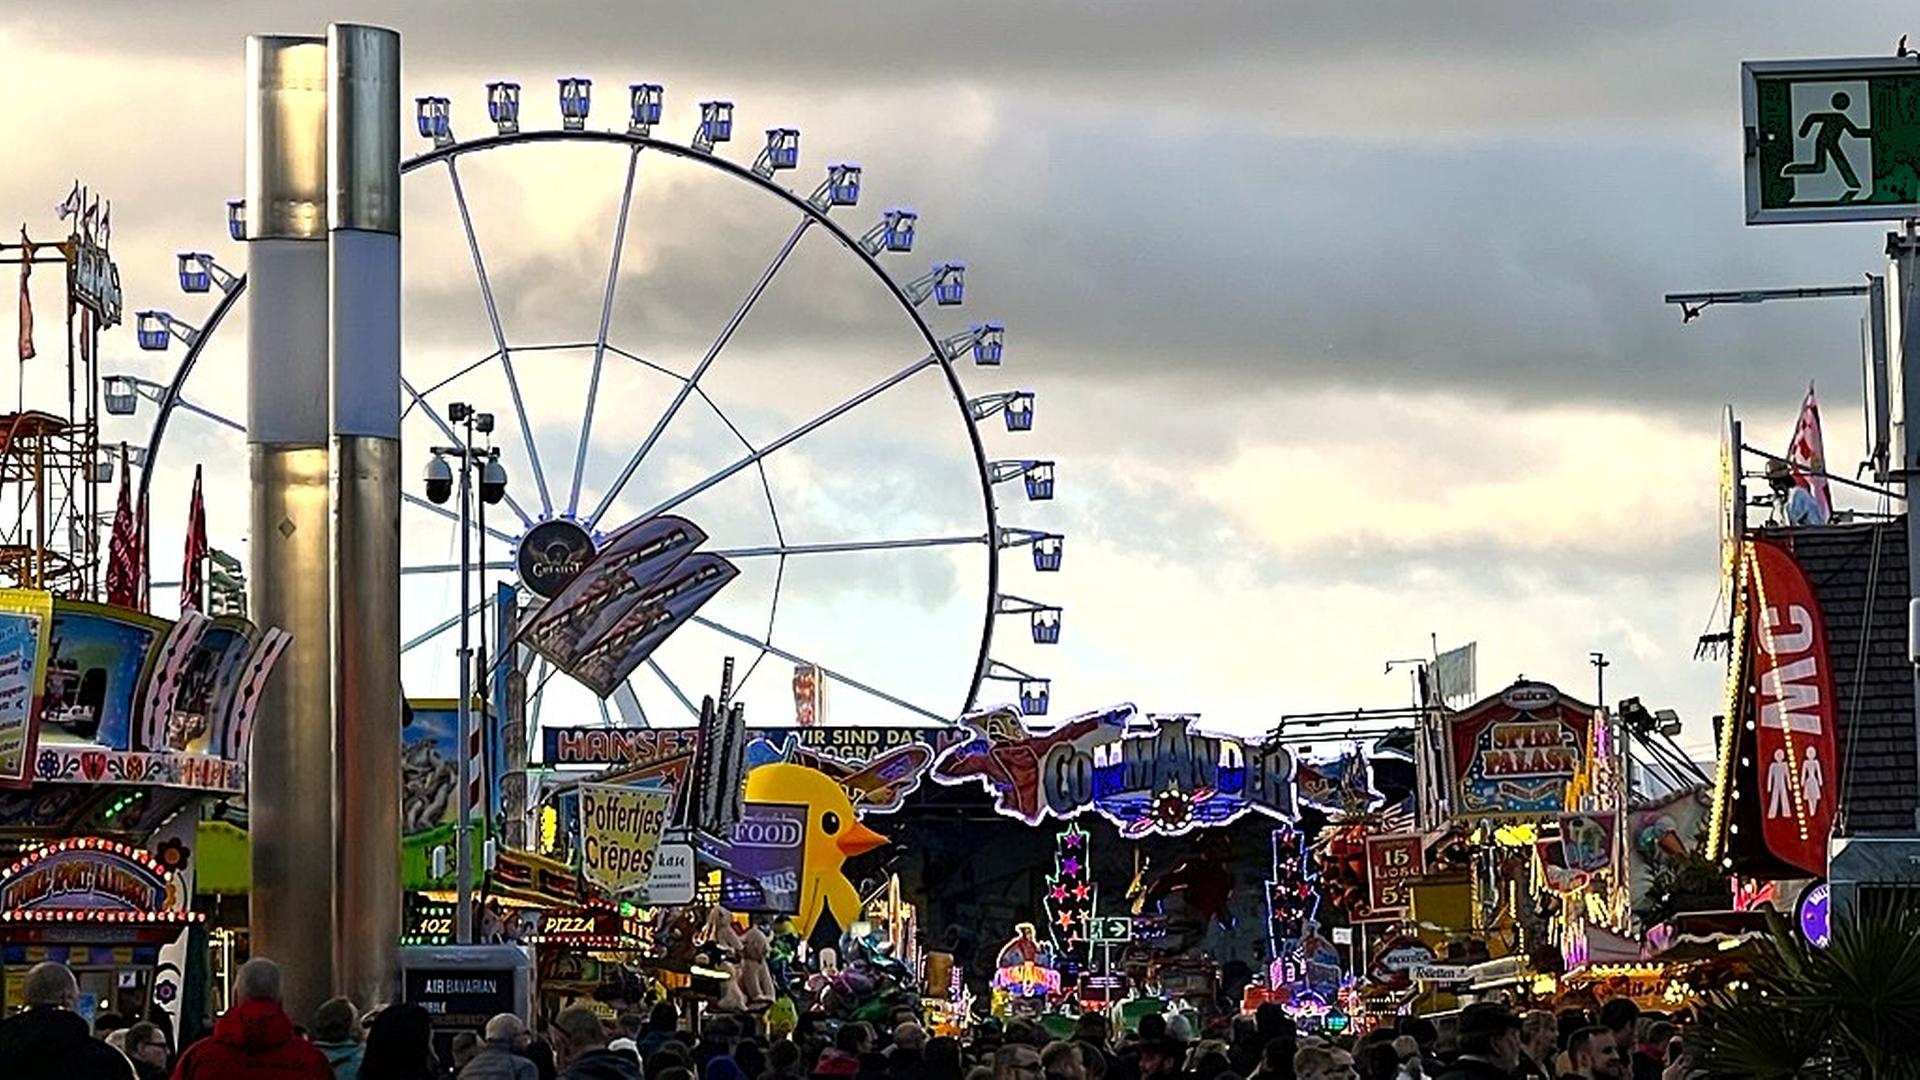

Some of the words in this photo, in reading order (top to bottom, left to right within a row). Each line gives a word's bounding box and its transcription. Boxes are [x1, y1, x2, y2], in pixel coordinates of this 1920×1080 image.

[1758, 605, 1822, 735] WC
[833, 730, 880, 745] SIND
[886, 730, 925, 745] DAS
[584, 795, 664, 843] Poffertjes
[734, 823, 796, 842] FOOD
[585, 835, 655, 879] Crêpes
[1384, 848, 1410, 866] 15
[543, 917, 595, 933] PIZZA
[424, 979, 444, 993] AIR
[446, 979, 497, 993] BAVARIAN
